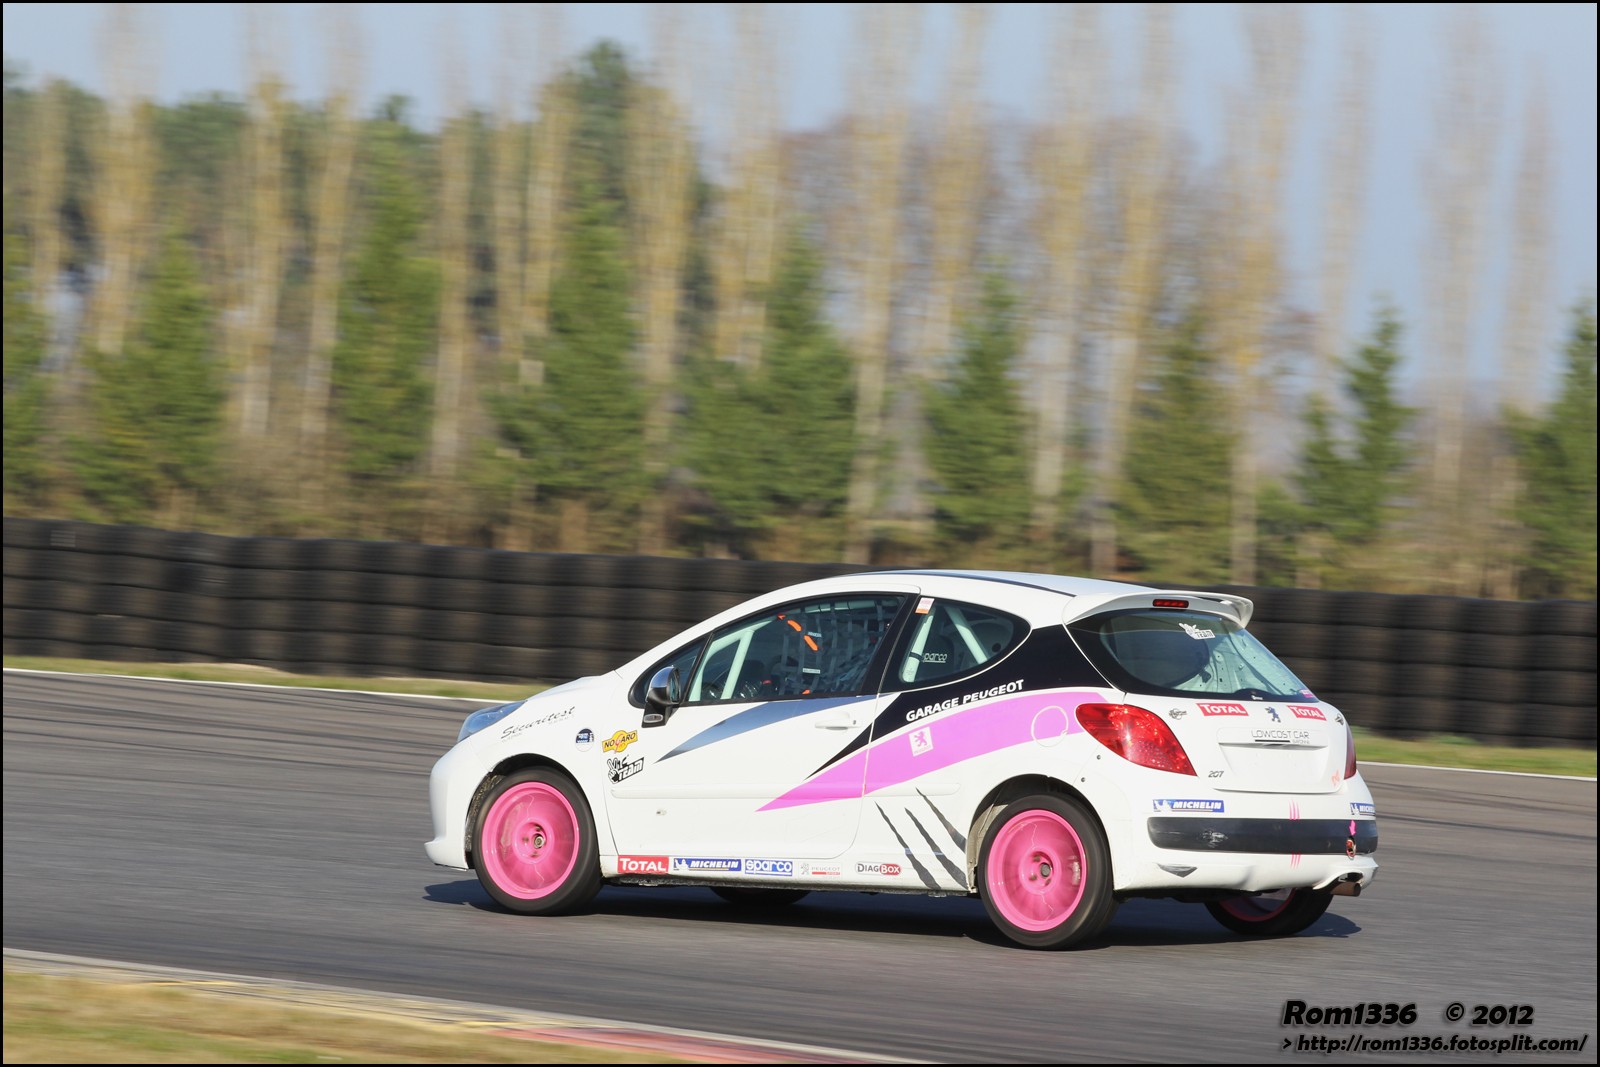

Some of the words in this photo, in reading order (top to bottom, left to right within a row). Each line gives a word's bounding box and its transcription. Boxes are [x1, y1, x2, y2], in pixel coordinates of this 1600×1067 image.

[923, 652, 948, 661] parco
[905, 697, 959, 722] GARAGE
[963, 679, 1024, 704] PEUGEOT
[1200, 704, 1246, 714] TOTAL
[1290, 706, 1325, 719] TOTAL
[1251, 729, 1291, 738] LOWCOST
[1293, 730, 1309, 739] CAR
[1208, 770, 1224, 778] 207
[1172, 801, 1222, 810] MICHELIN
[619, 857, 667, 872] TOTAL
[689, 860, 739, 868] MICHELIN
[745, 859, 792, 873] sparco
